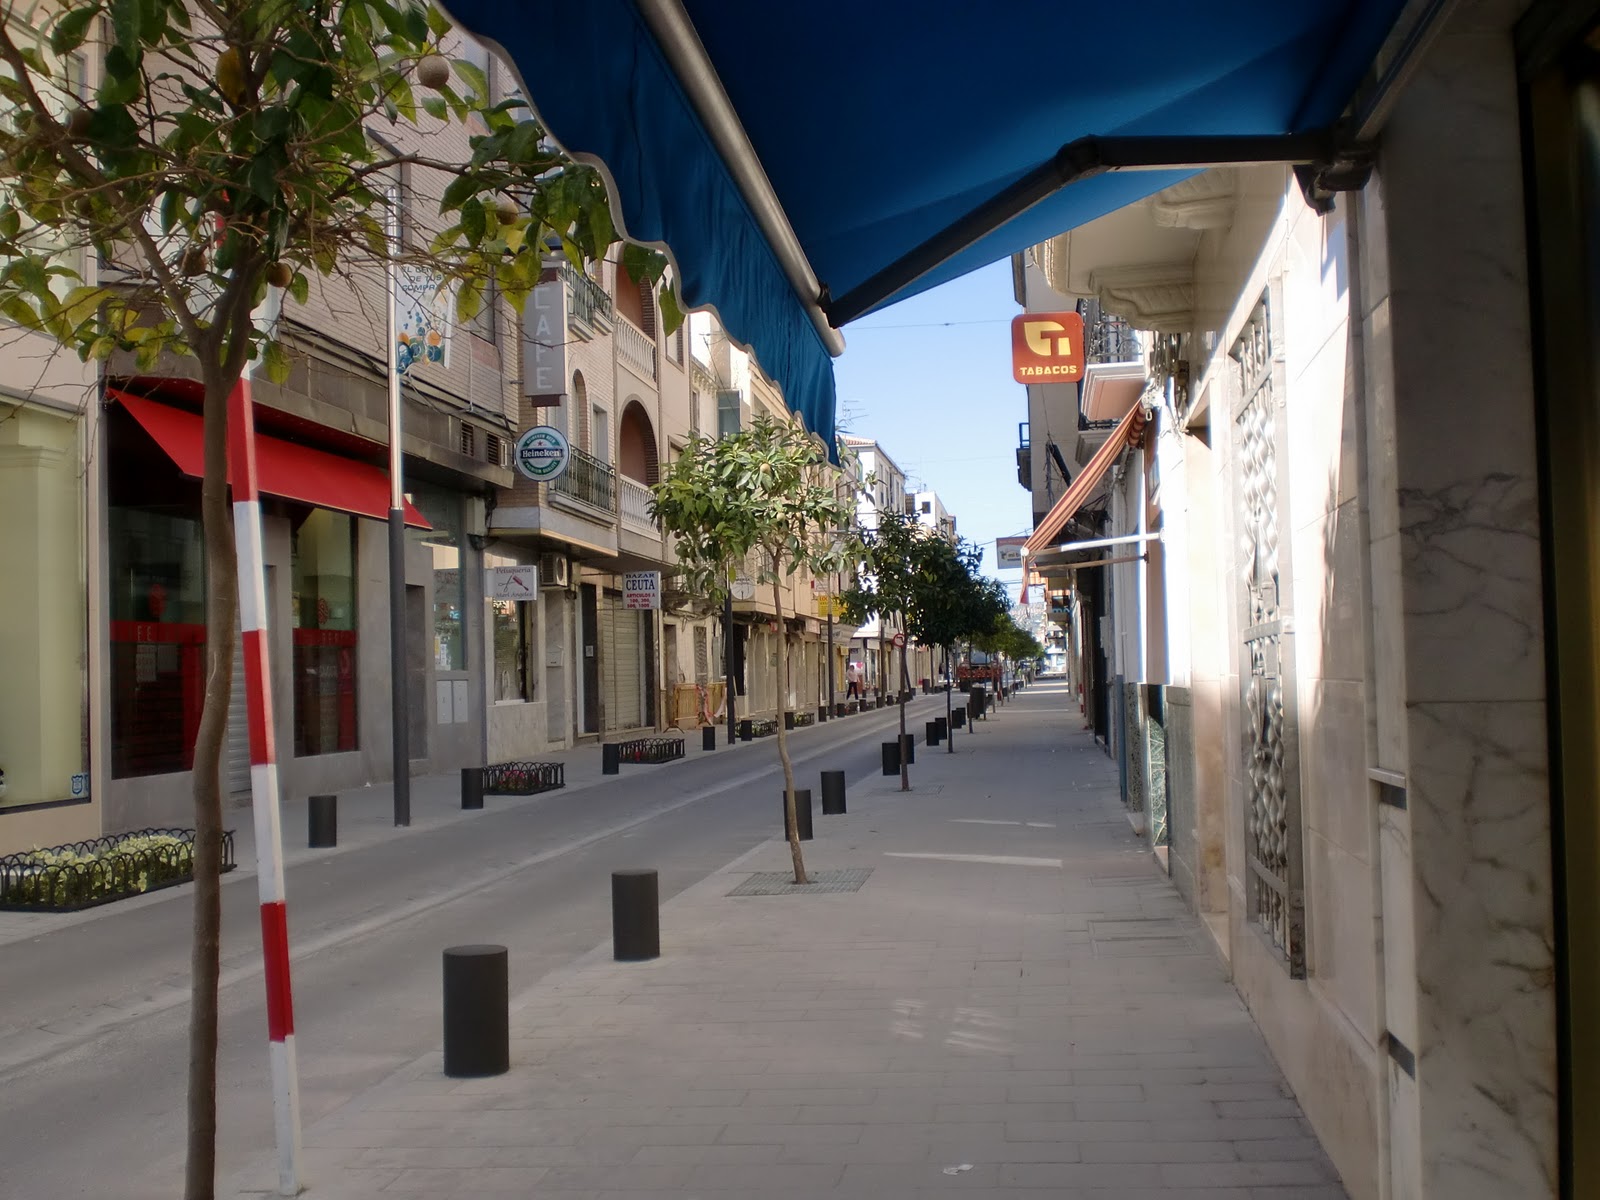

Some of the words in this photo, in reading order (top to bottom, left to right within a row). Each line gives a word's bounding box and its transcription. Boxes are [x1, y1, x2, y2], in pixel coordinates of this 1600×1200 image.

[534, 286, 553, 389] CAFE
[1020, 365, 1077, 376] TABACOS
[522, 449, 561, 458] Heineken
[625, 579, 655, 591] CEUTA
